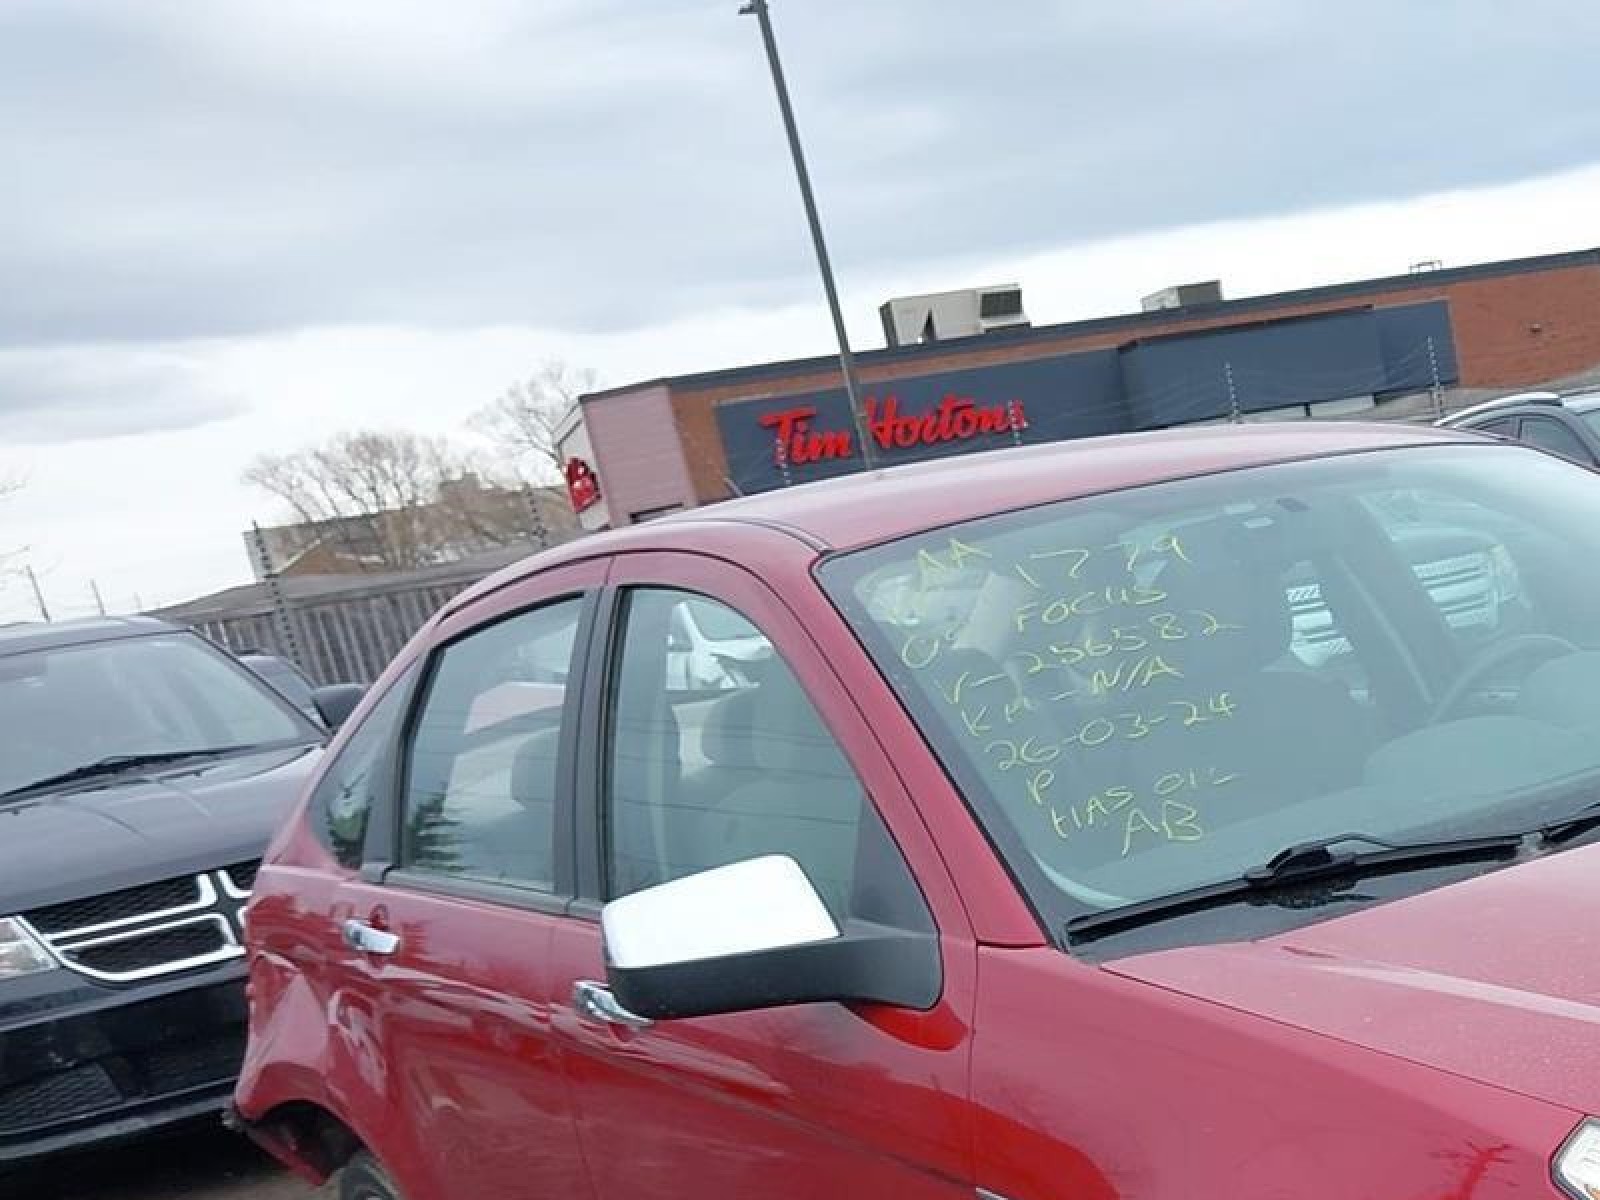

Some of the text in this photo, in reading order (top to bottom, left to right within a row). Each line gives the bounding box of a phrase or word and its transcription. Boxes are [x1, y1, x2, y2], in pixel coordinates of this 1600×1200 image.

[759, 393, 1028, 466] Tim Hortons
[1121, 799, 1202, 857] AB
